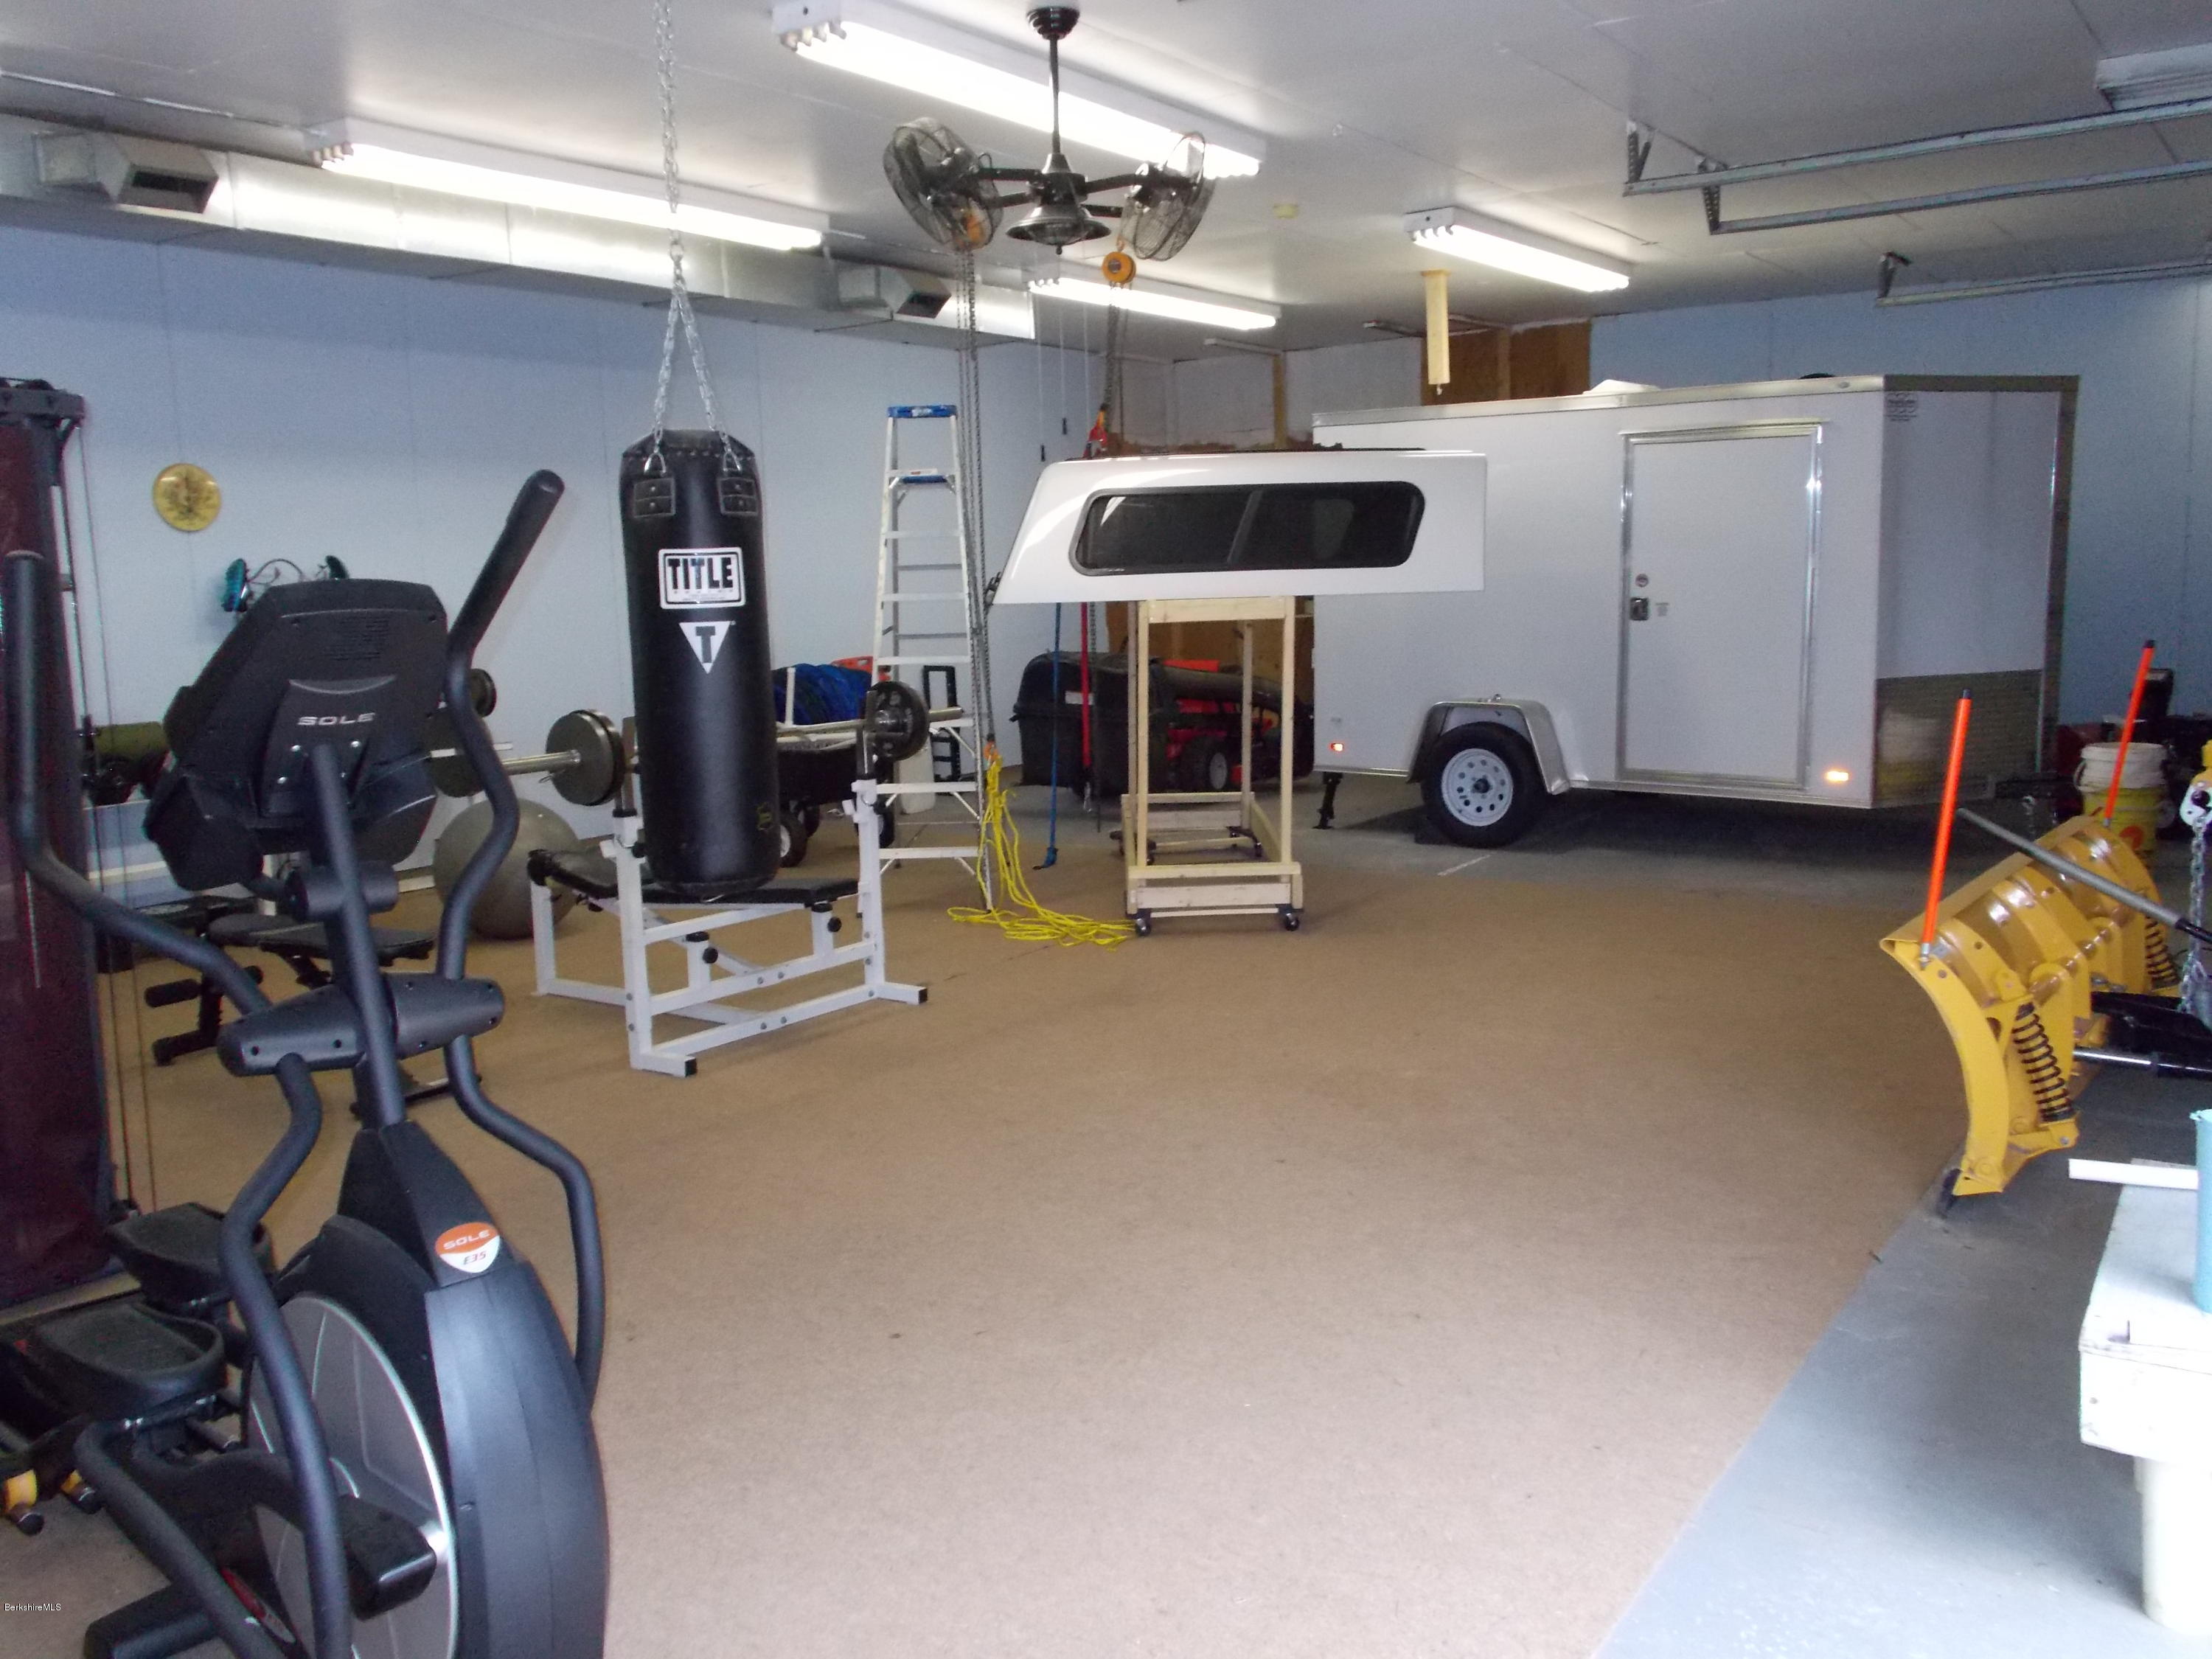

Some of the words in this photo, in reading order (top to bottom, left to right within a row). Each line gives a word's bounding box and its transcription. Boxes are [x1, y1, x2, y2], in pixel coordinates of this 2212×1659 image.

[667, 557, 734, 590] TITLE
[695, 625, 716, 664] T
[297, 712, 376, 726] SOLE
[442, 1229, 490, 1250] SOLE
[462, 1251, 487, 1265] E35
